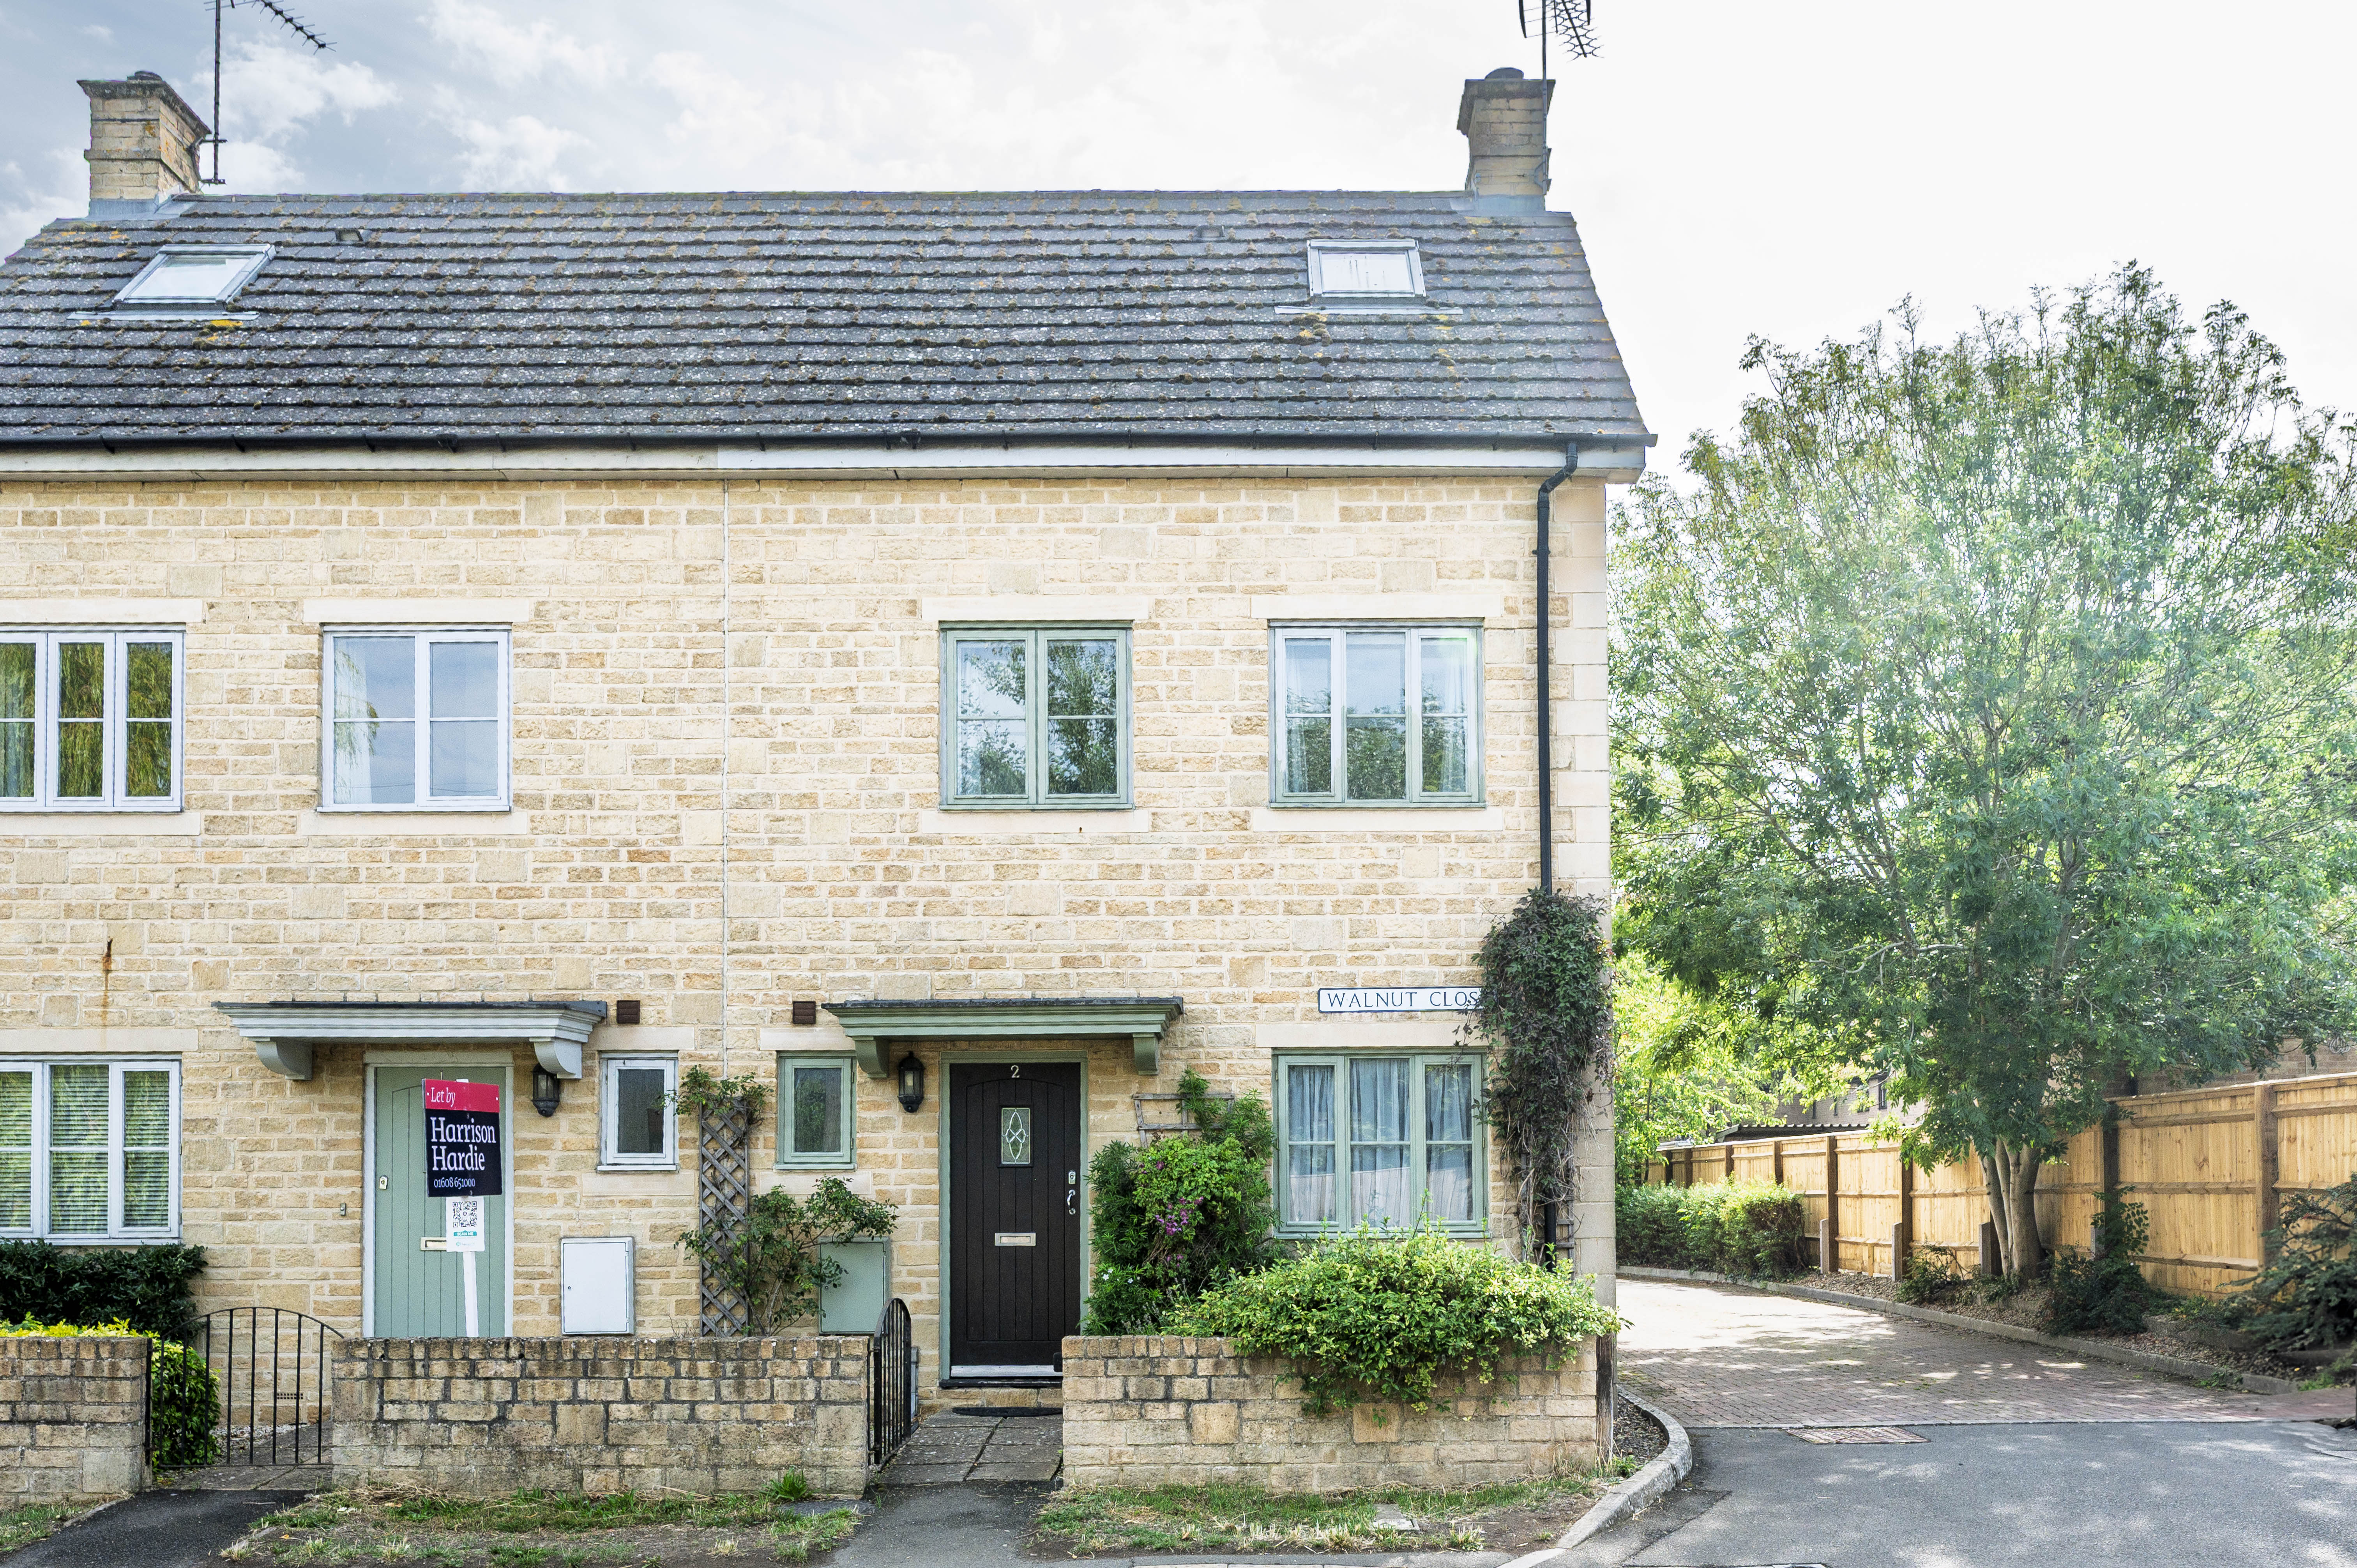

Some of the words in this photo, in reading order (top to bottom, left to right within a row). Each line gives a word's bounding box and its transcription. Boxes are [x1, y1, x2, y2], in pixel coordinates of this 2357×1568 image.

[1327, 992, 1417, 1007] WALNUT
[1429, 991, 1479, 1006] CLOS
[1011, 1065, 1020, 1079] 2
[431, 1087, 445, 1103] Let
[446, 1088, 456, 1107] by
[430, 1116, 496, 1144] Harrison
[431, 1144, 485, 1171] Hardie
[434, 1177, 454, 1188] 01608
[454, 1177, 475, 1189] 651000
